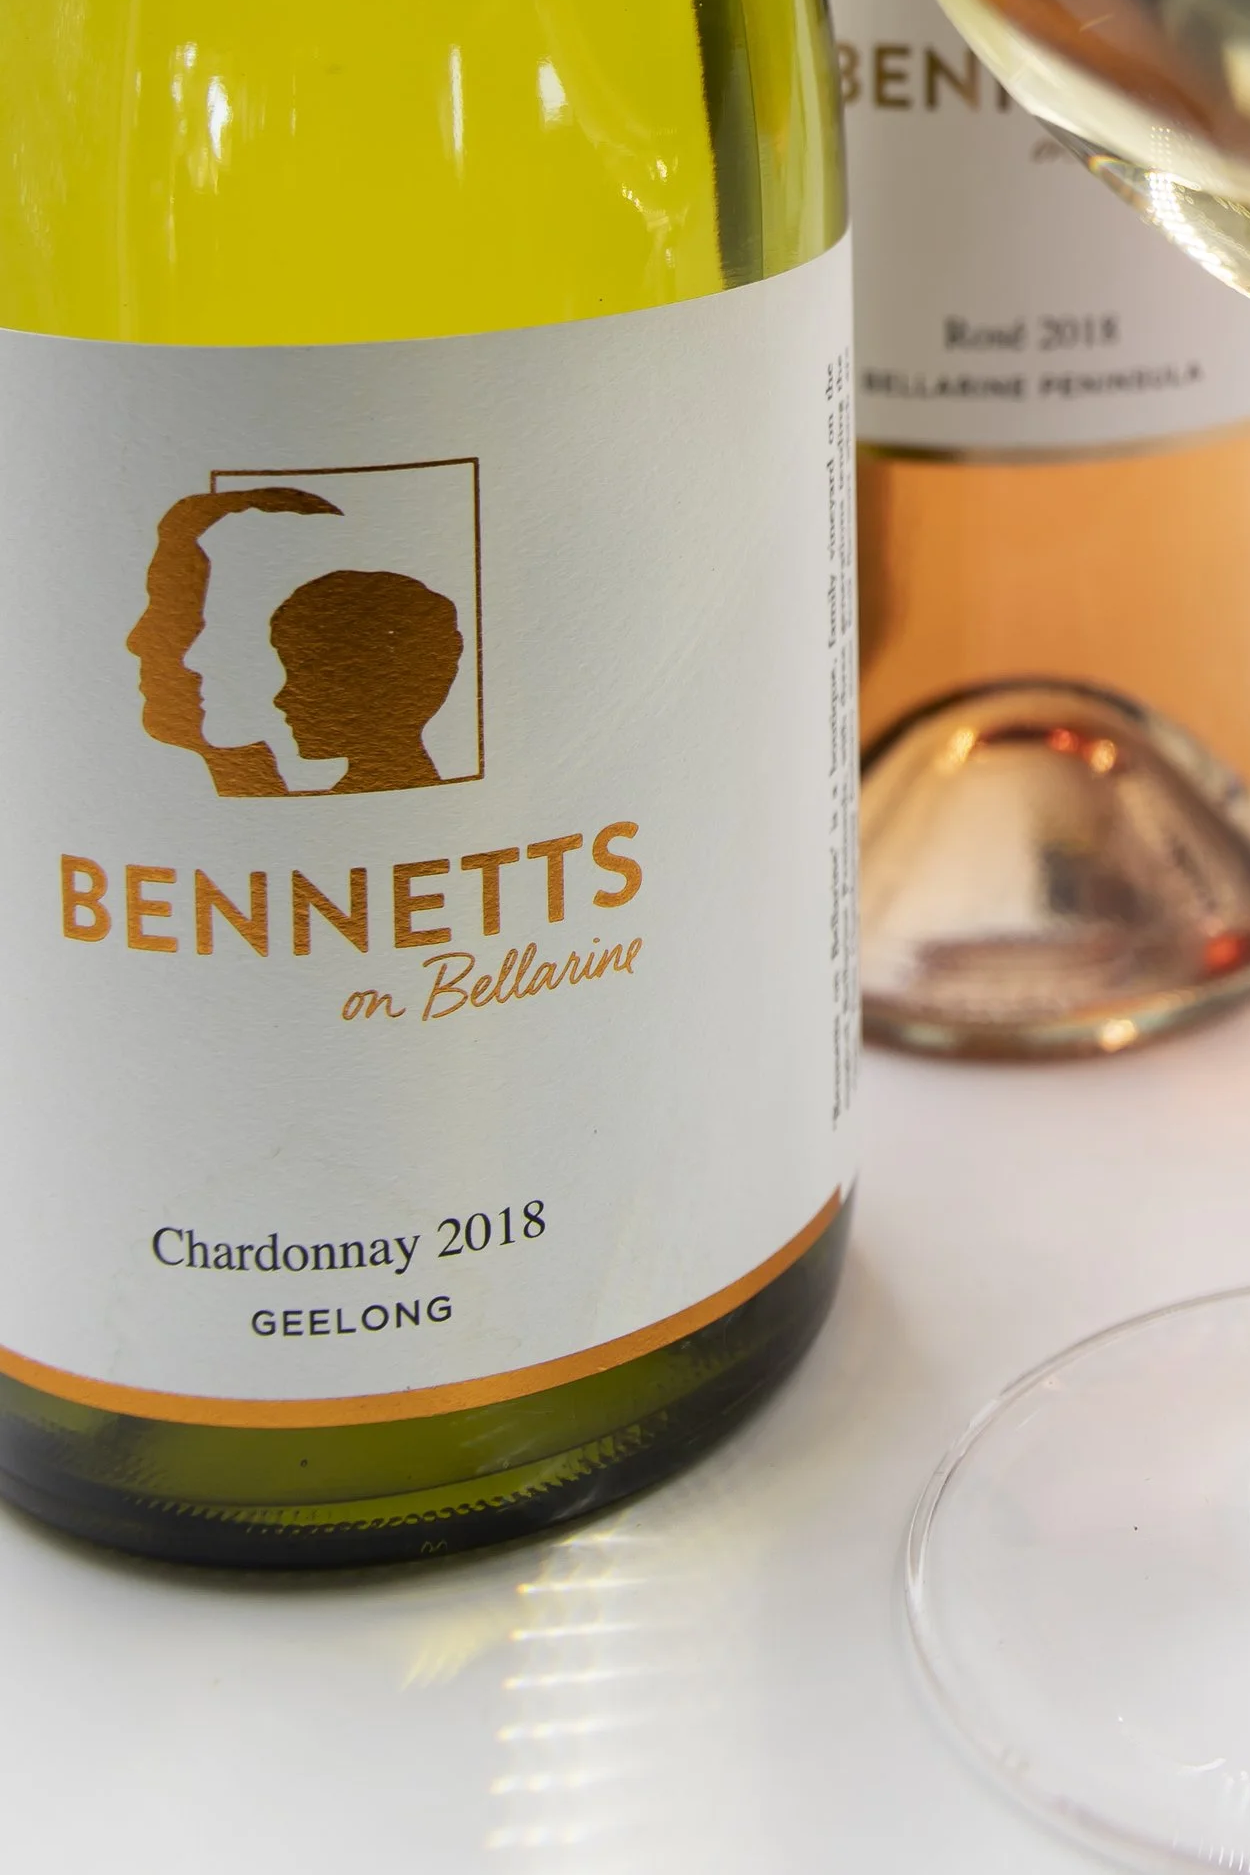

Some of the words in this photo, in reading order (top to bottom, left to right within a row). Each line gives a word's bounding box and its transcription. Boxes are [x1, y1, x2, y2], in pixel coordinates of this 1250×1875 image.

[826, 458, 837, 561] vineyard
[827, 573, 837, 650] family
[61, 820, 643, 958] BENNETTS
[342, 988, 406, 1022] on
[422, 935, 643, 1022] Bellarine
[152, 1226, 422, 1276] Chardonnay
[437, 1199, 546, 1259] 2018
[251, 1295, 453, 1338] GEELONG
